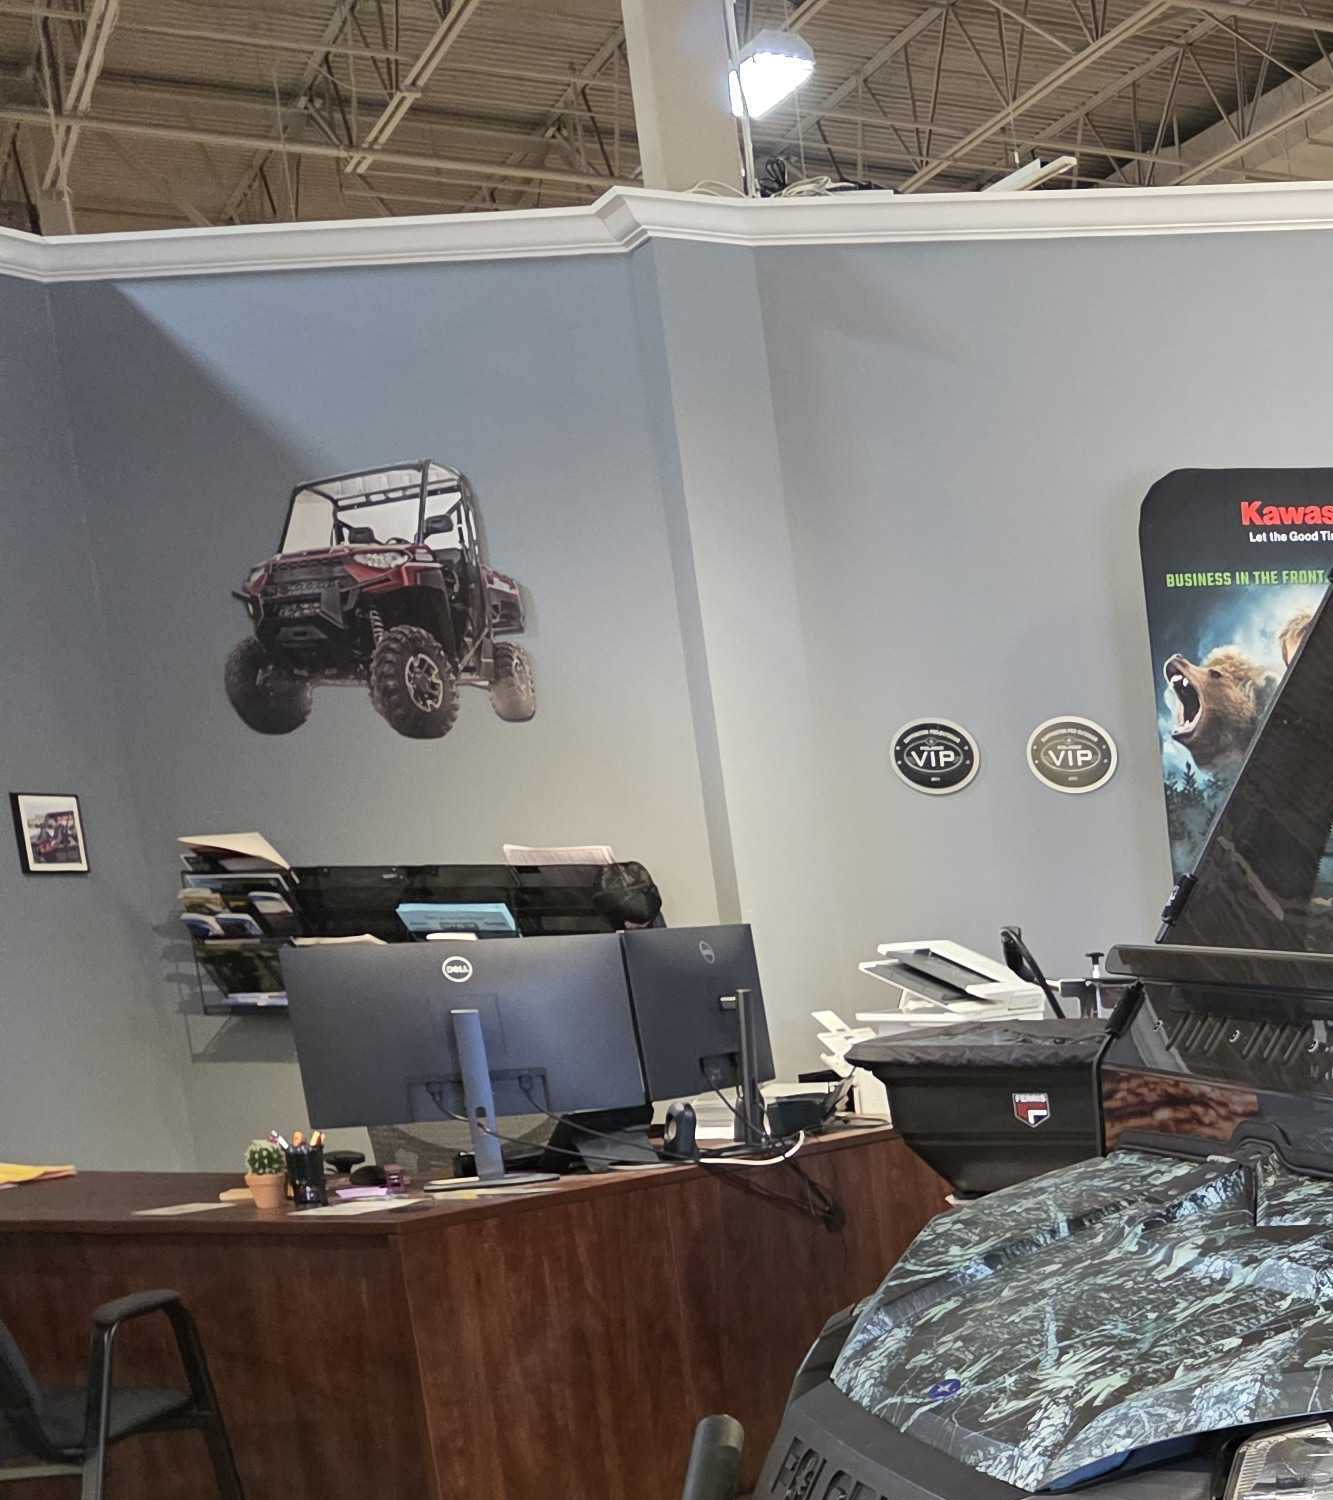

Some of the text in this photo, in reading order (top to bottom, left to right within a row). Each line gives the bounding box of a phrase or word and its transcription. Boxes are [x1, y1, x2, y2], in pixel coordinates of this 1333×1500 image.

[1249, 530, 1267, 543] Let
[1269, 530, 1288, 543] the
[1289, 530, 1319, 542] Good
[1166, 572, 1232, 588] BUSINESS
[1236, 571, 1249, 585] IN
[1253, 570, 1279, 585] THE
[911, 750, 955, 767] VIP
[1048, 749, 1093, 767] VIP
